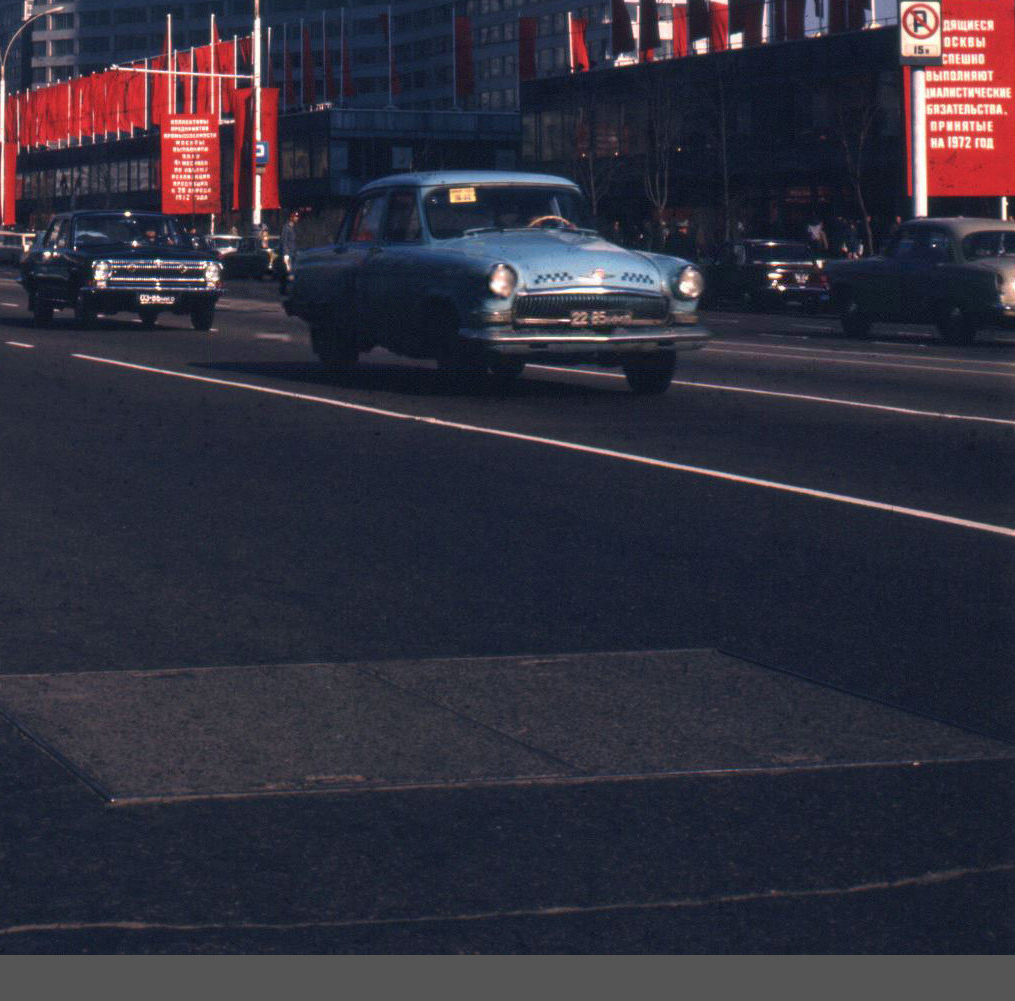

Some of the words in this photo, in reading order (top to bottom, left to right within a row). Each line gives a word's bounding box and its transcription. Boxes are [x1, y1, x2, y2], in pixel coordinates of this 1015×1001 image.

[943, 19, 995, 32] ДЯЩИЕСЯ
[943, 36, 986, 48] ОСКВЫ
[942, 53, 986, 65] СПЕШНО
[926, 70, 994, 82] ВЫПОЛНЯЮТ
[925, 87, 1012, 99] ИАЛИСТИЧЕСКИЕ
[930, 120, 994, 133] ПРИНЯТЫЕ
[930, 136, 946, 149] НА
[947, 135, 973, 149] 1972
[975, 136, 995, 150] ГОД
